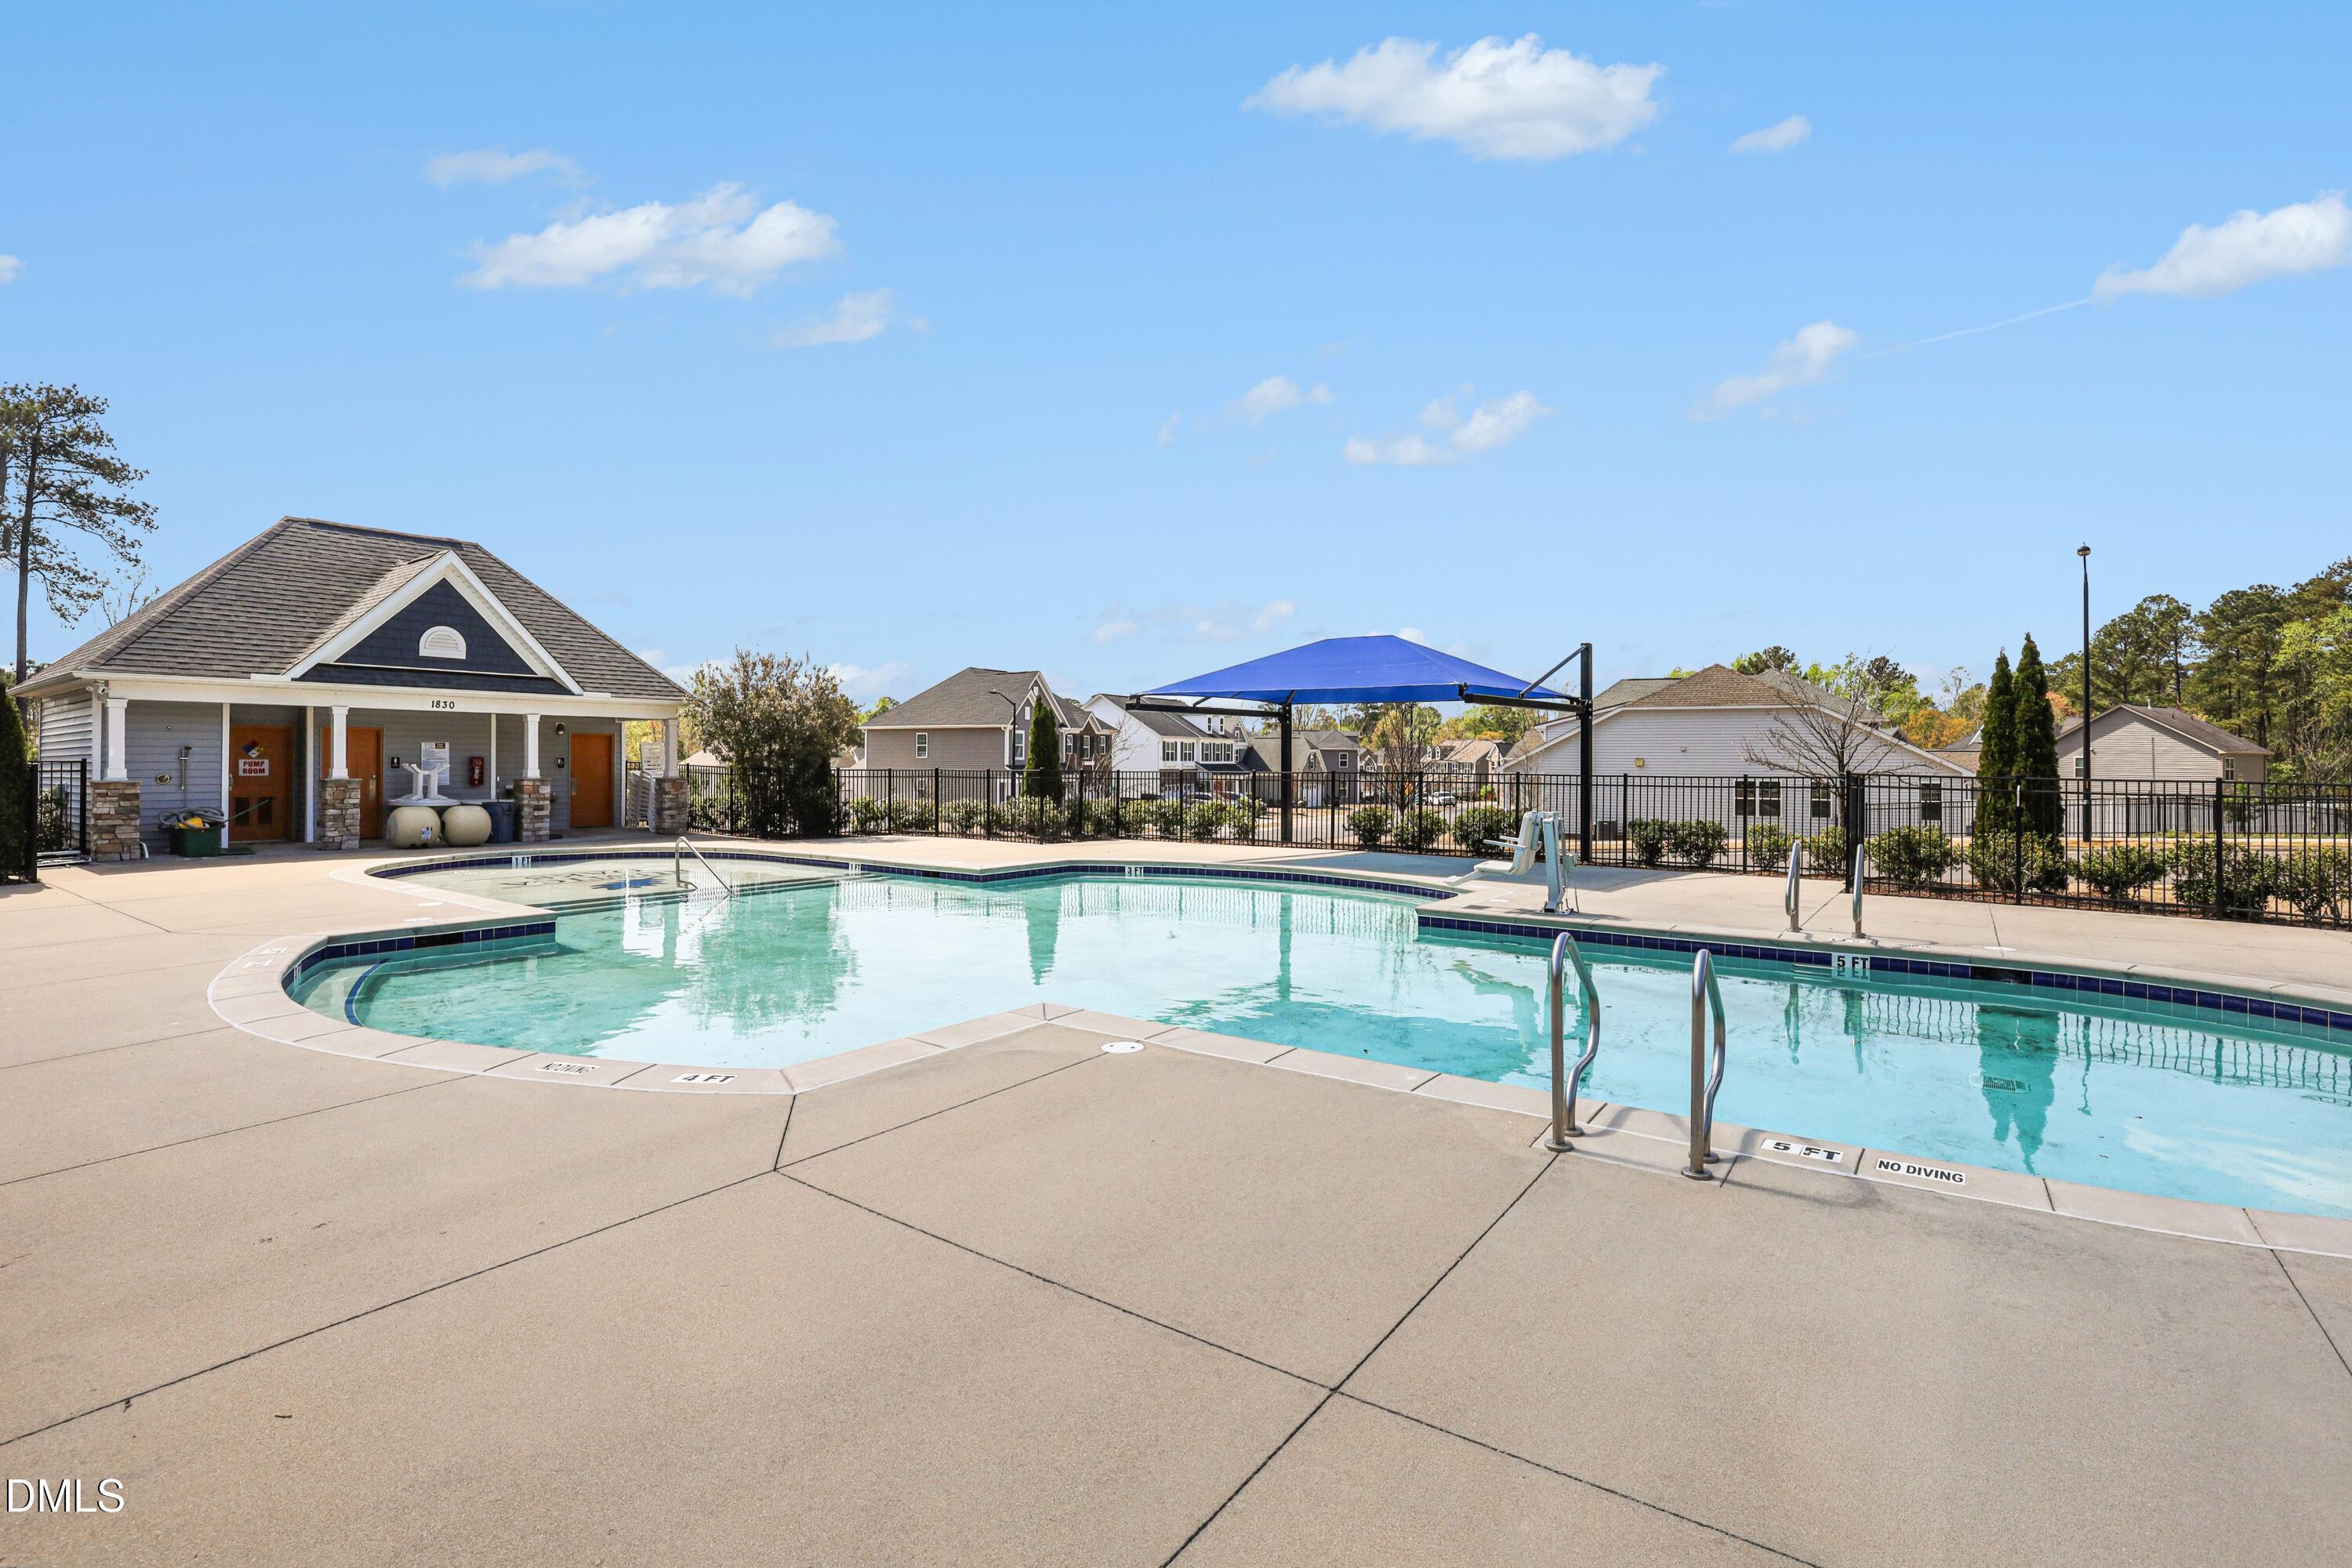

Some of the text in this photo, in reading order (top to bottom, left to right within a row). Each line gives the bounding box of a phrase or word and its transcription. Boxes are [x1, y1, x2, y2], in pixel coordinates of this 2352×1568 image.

[431, 700, 455, 709] 1830
[522, 856, 531, 868] FT
[1127, 866, 1143, 877] 3 FT
[1837, 955, 1869, 969] 5 FT
[1773, 1142, 1842, 1160] 5 FT
[1878, 1160, 1964, 1183] NO DIVING
